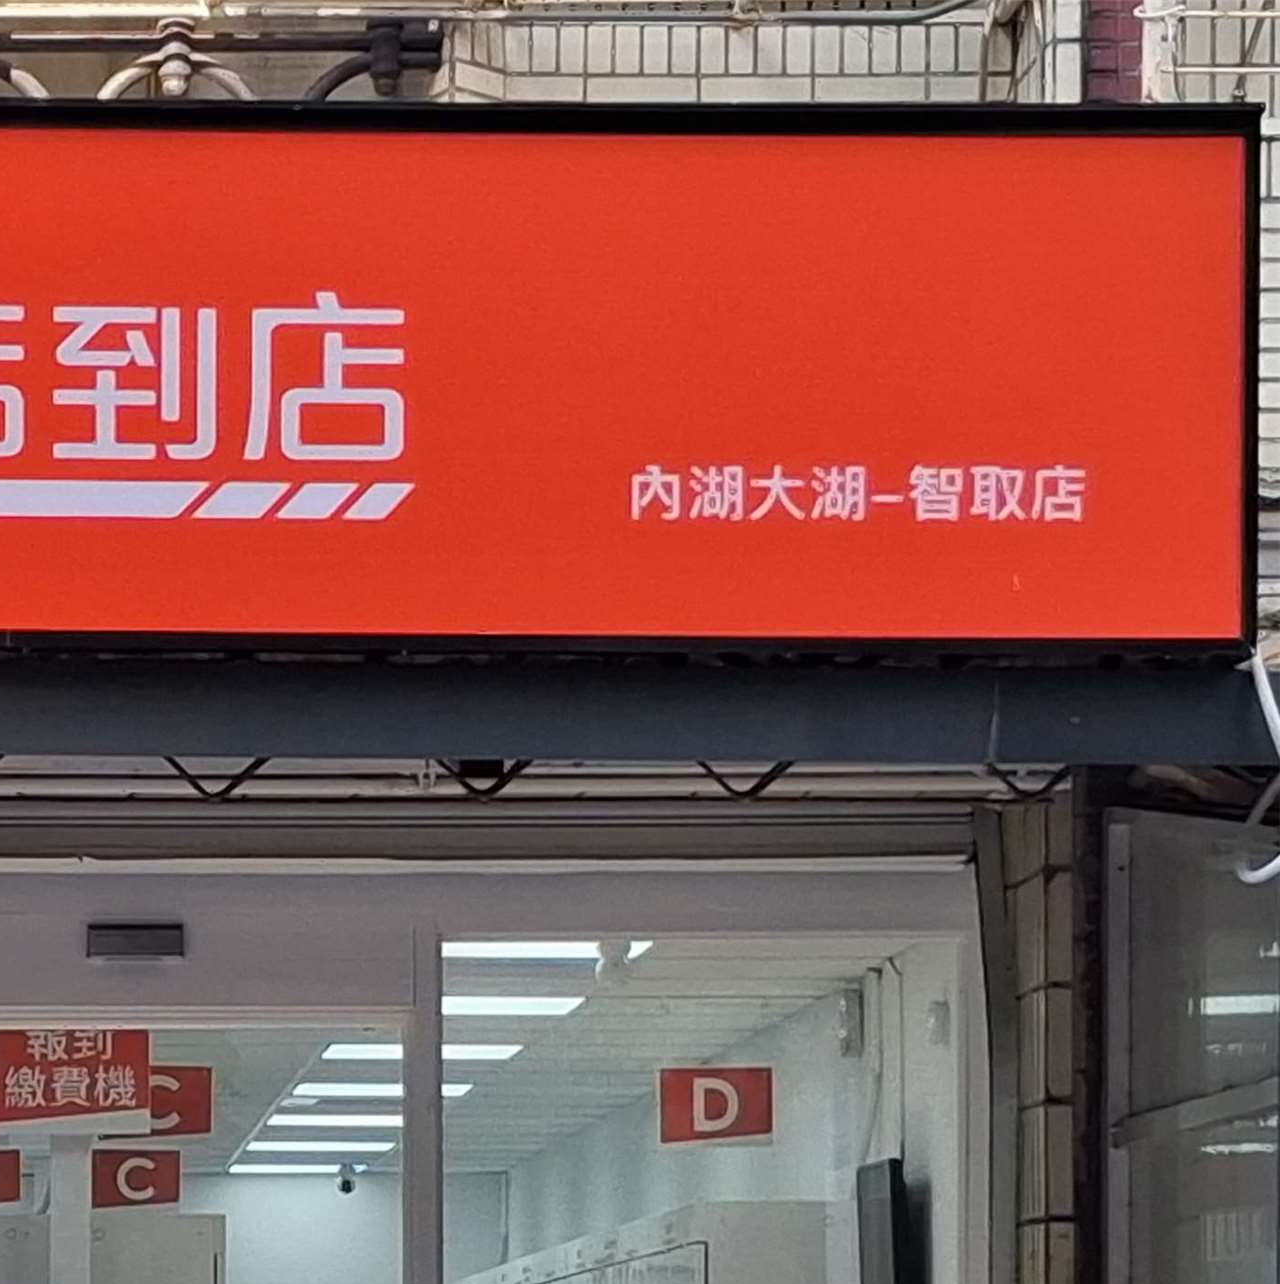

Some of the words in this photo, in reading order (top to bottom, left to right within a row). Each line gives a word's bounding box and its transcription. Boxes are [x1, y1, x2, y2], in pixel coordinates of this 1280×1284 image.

[25, 1031, 114, 1062] 報到
[4, 1065, 137, 1108] 繳費機
[150, 1074, 181, 1130] C
[693, 1076, 739, 1132] D
[116, 1157, 156, 1200] C
